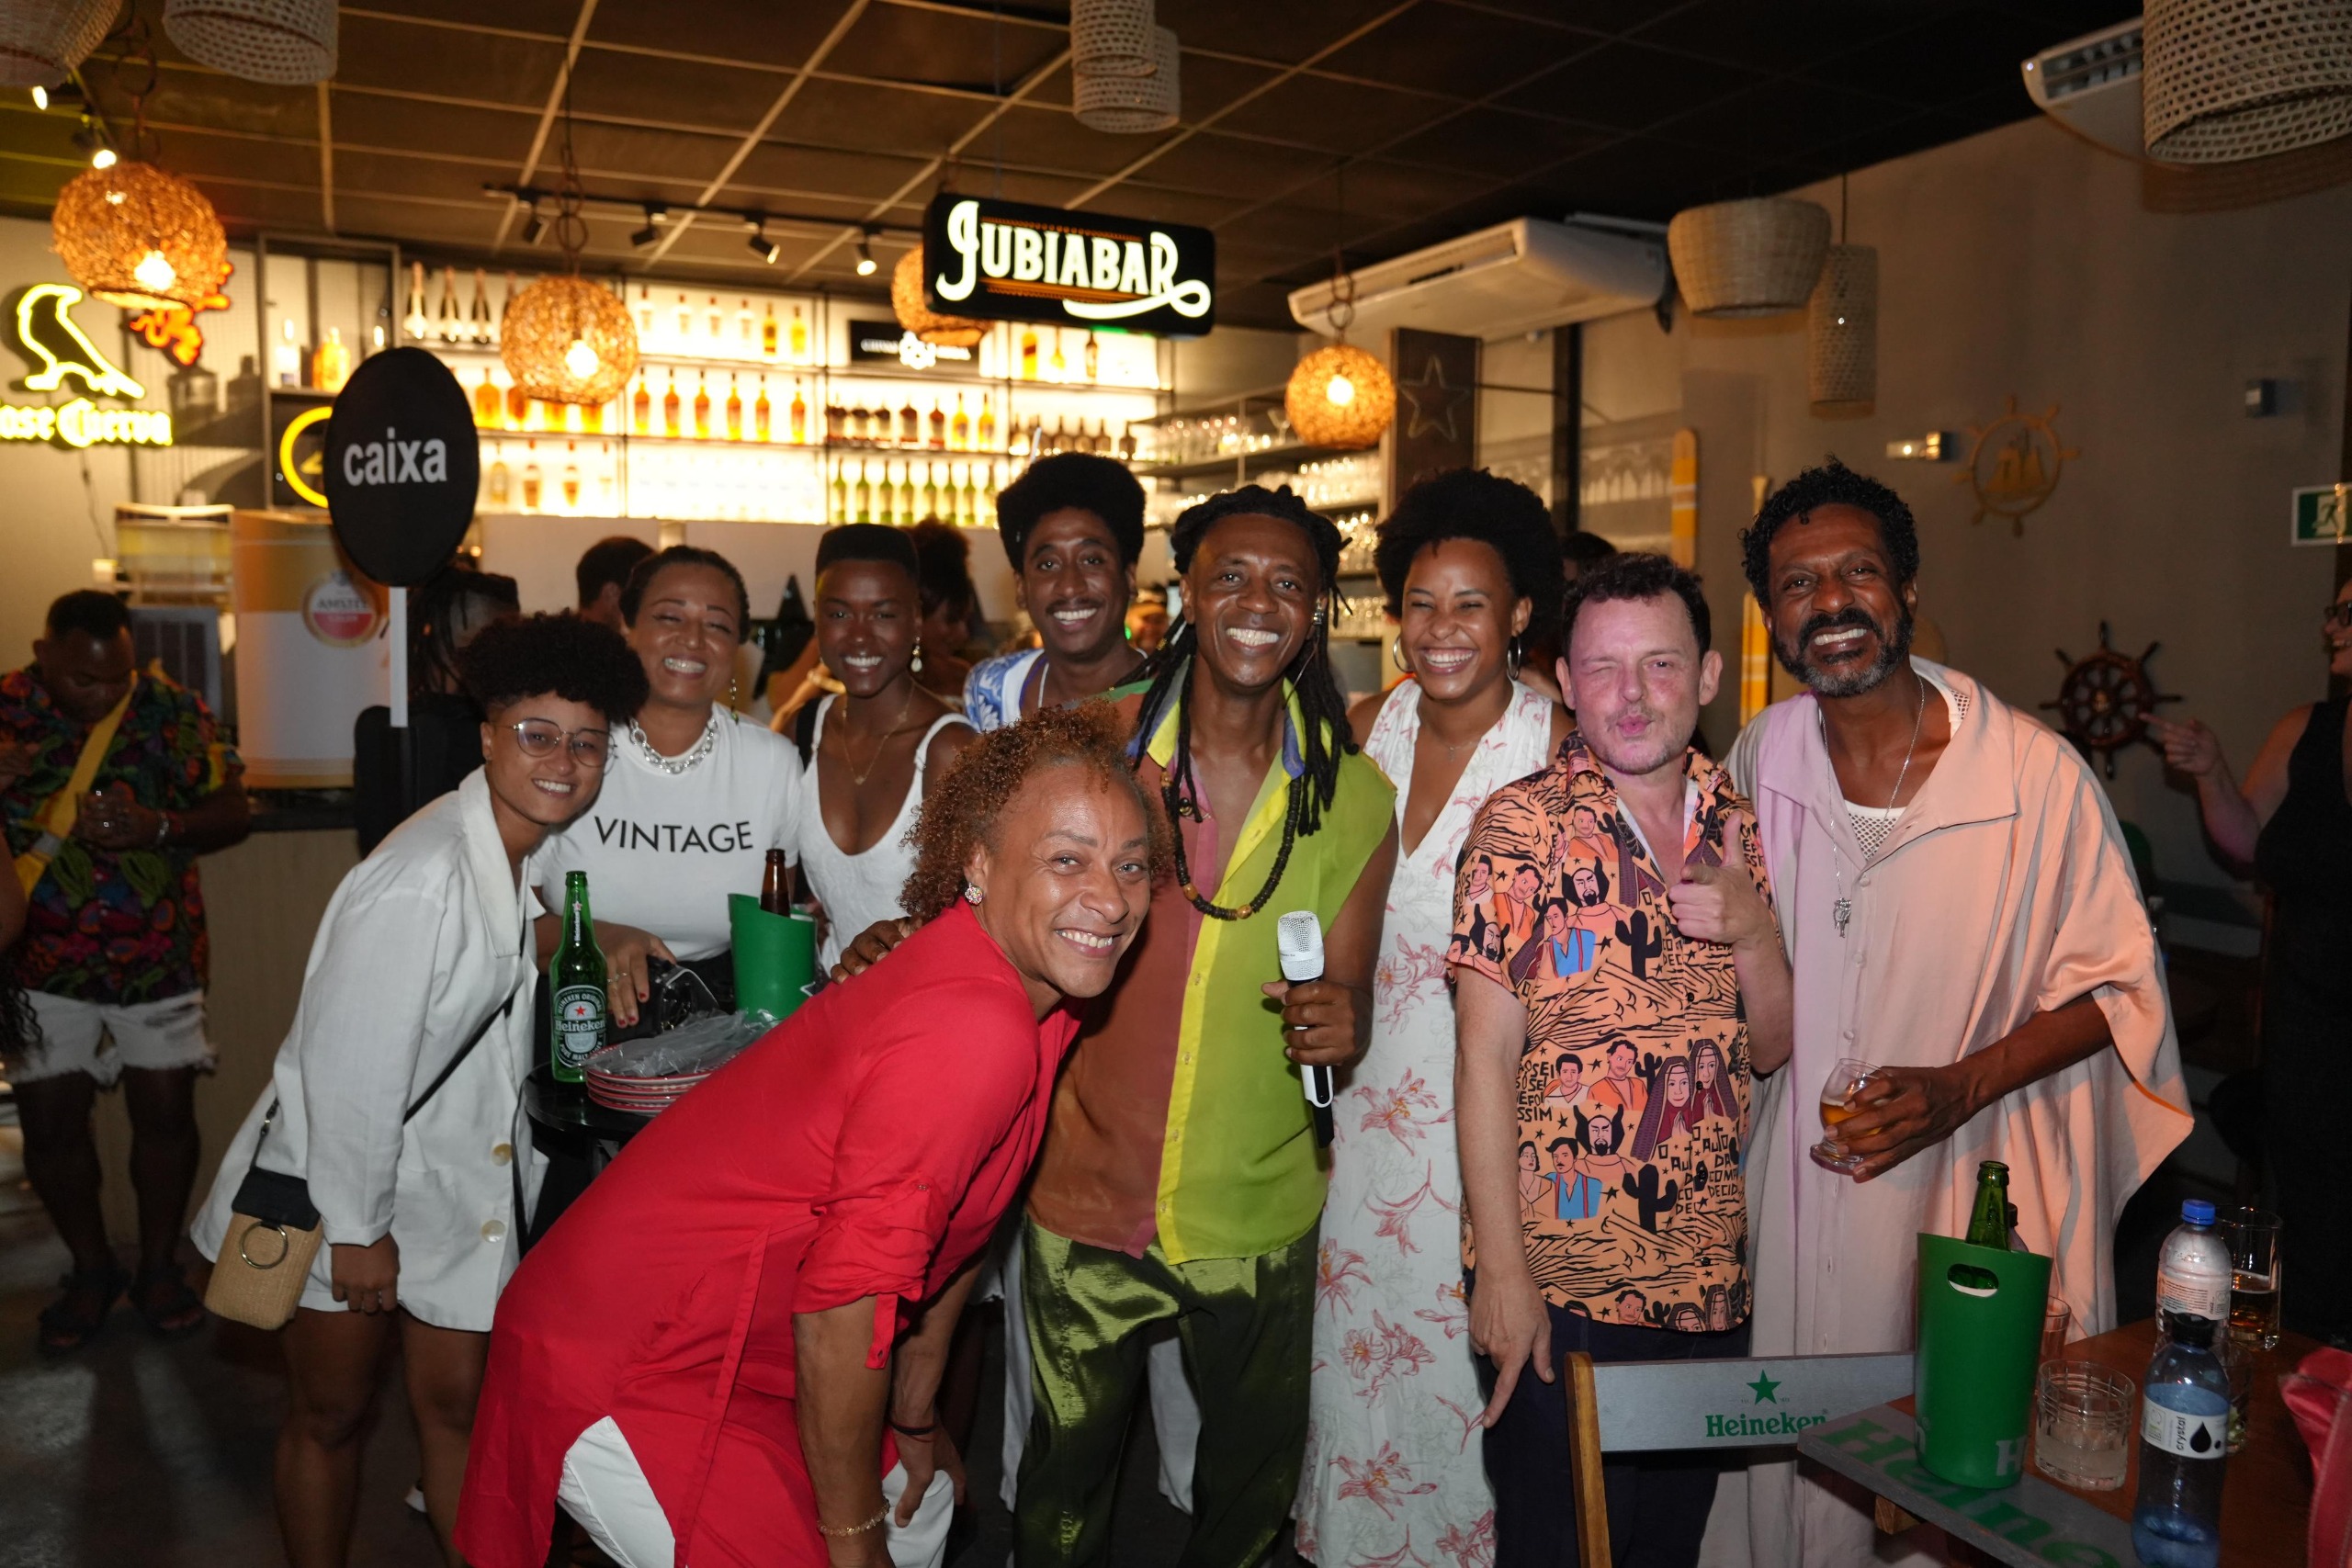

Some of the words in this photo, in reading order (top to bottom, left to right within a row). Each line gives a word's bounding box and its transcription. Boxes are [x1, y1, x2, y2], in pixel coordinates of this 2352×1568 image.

[935, 200, 1211, 320] JUBIABAR
[0, 405, 56, 441] ose
[344, 426, 447, 487] caixa
[594, 815, 753, 853] VINTAGE
[559, 993, 581, 1014] HEINEKEN
[555, 1020, 605, 1032] Heineken
[1531, 1061, 1555, 1078] SEI
[1528, 1077, 1547, 1091] SEI
[1517, 1106, 1552, 1122] SSIM
[1670, 1141, 1692, 1171] AUT
[1707, 1183, 1738, 1198] DECID
[2177, 1416, 2187, 1450] crystal
